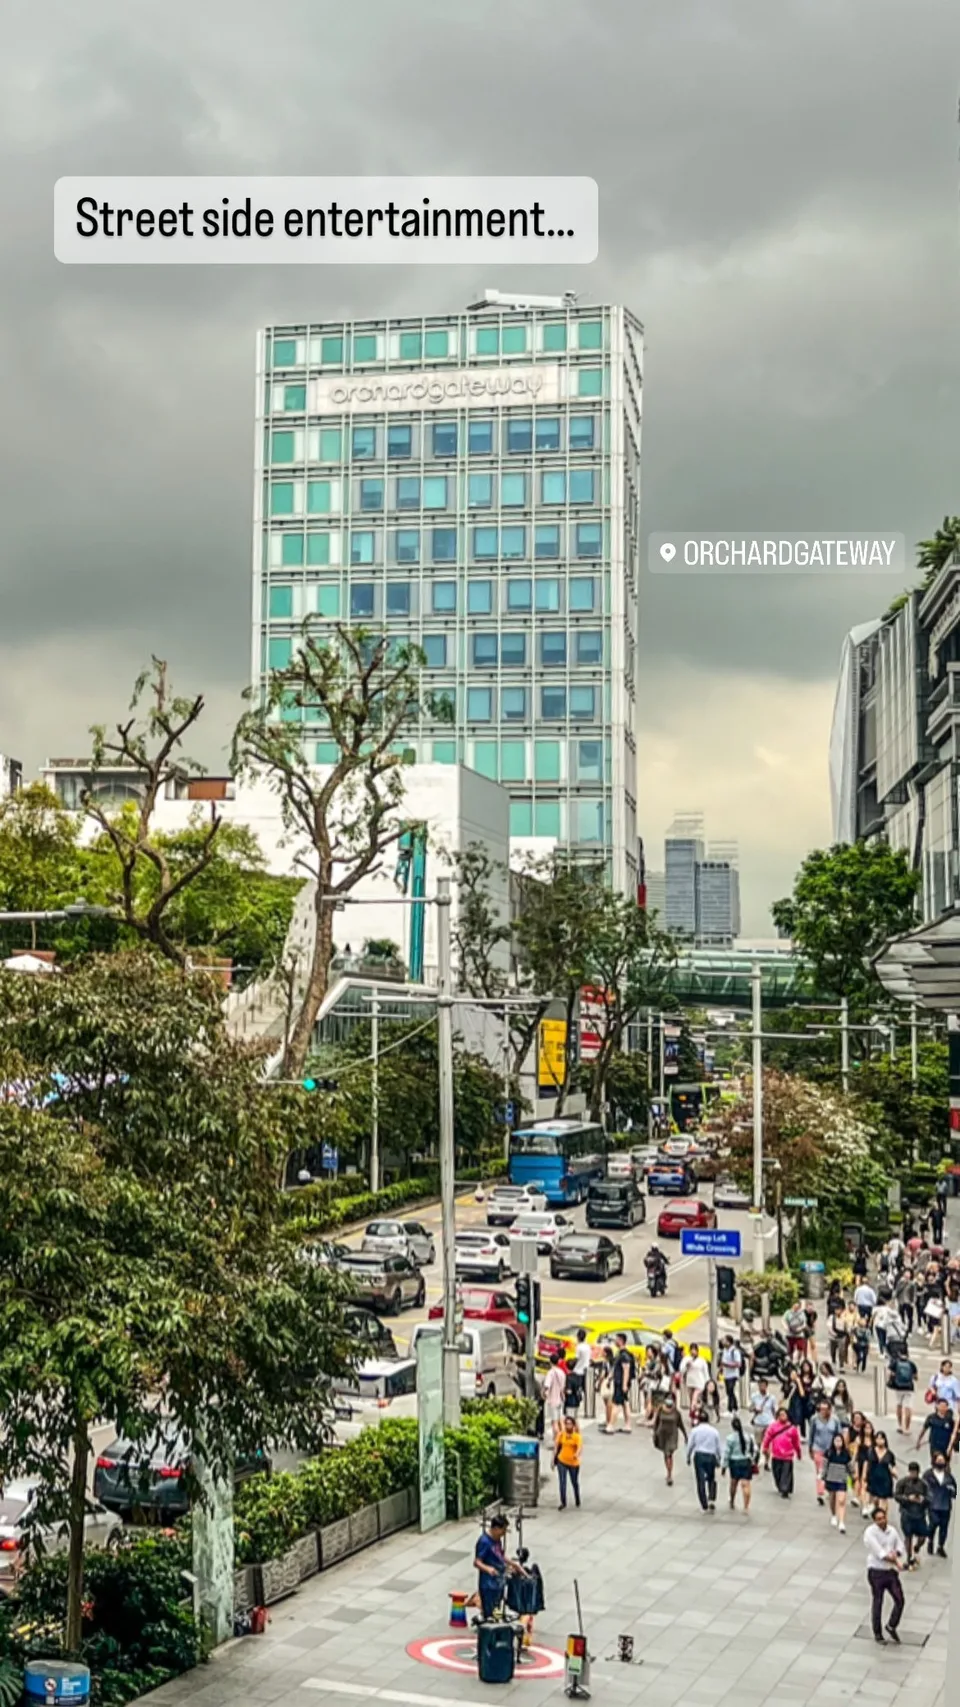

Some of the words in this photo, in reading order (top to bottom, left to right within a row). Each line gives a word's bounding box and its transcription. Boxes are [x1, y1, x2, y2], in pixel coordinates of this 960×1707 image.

[330, 374, 543, 404] orchardgateway
[694, 1233, 712, 1242] Keep
[714, 1233, 727, 1242] Left
[706, 1244, 737, 1254] Crossing
